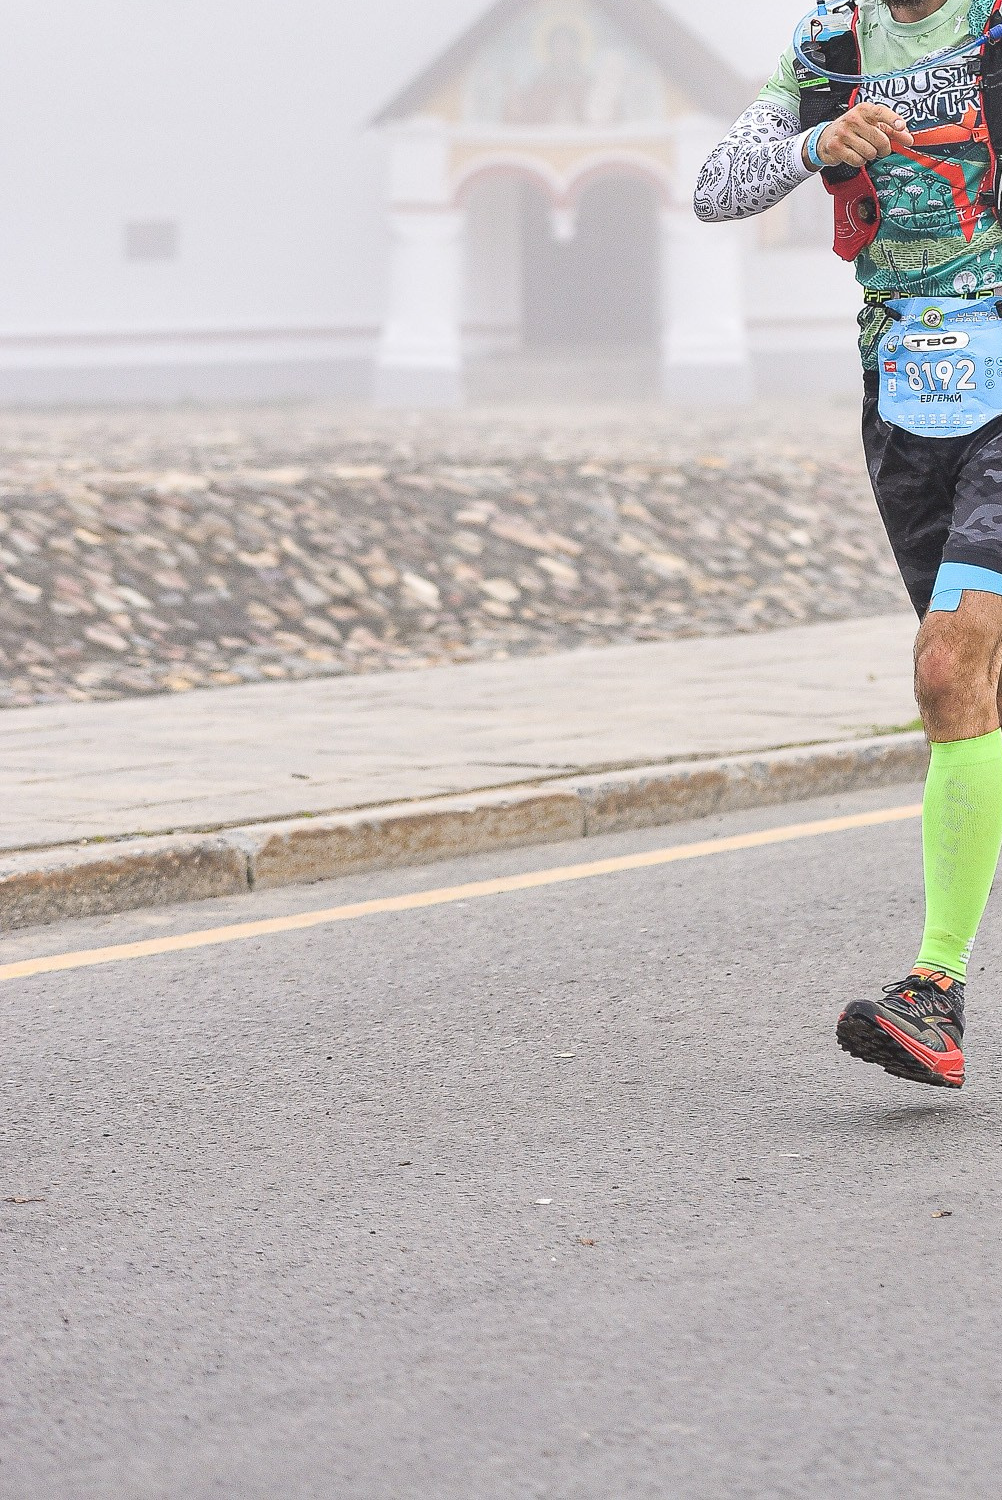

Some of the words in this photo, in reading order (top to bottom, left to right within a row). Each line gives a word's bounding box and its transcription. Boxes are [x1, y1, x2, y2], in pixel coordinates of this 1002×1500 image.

[911, 336, 957, 348] T80
[904, 358, 976, 392] 8192
[920, 392, 962, 404] ЕВГЕНИЙ
